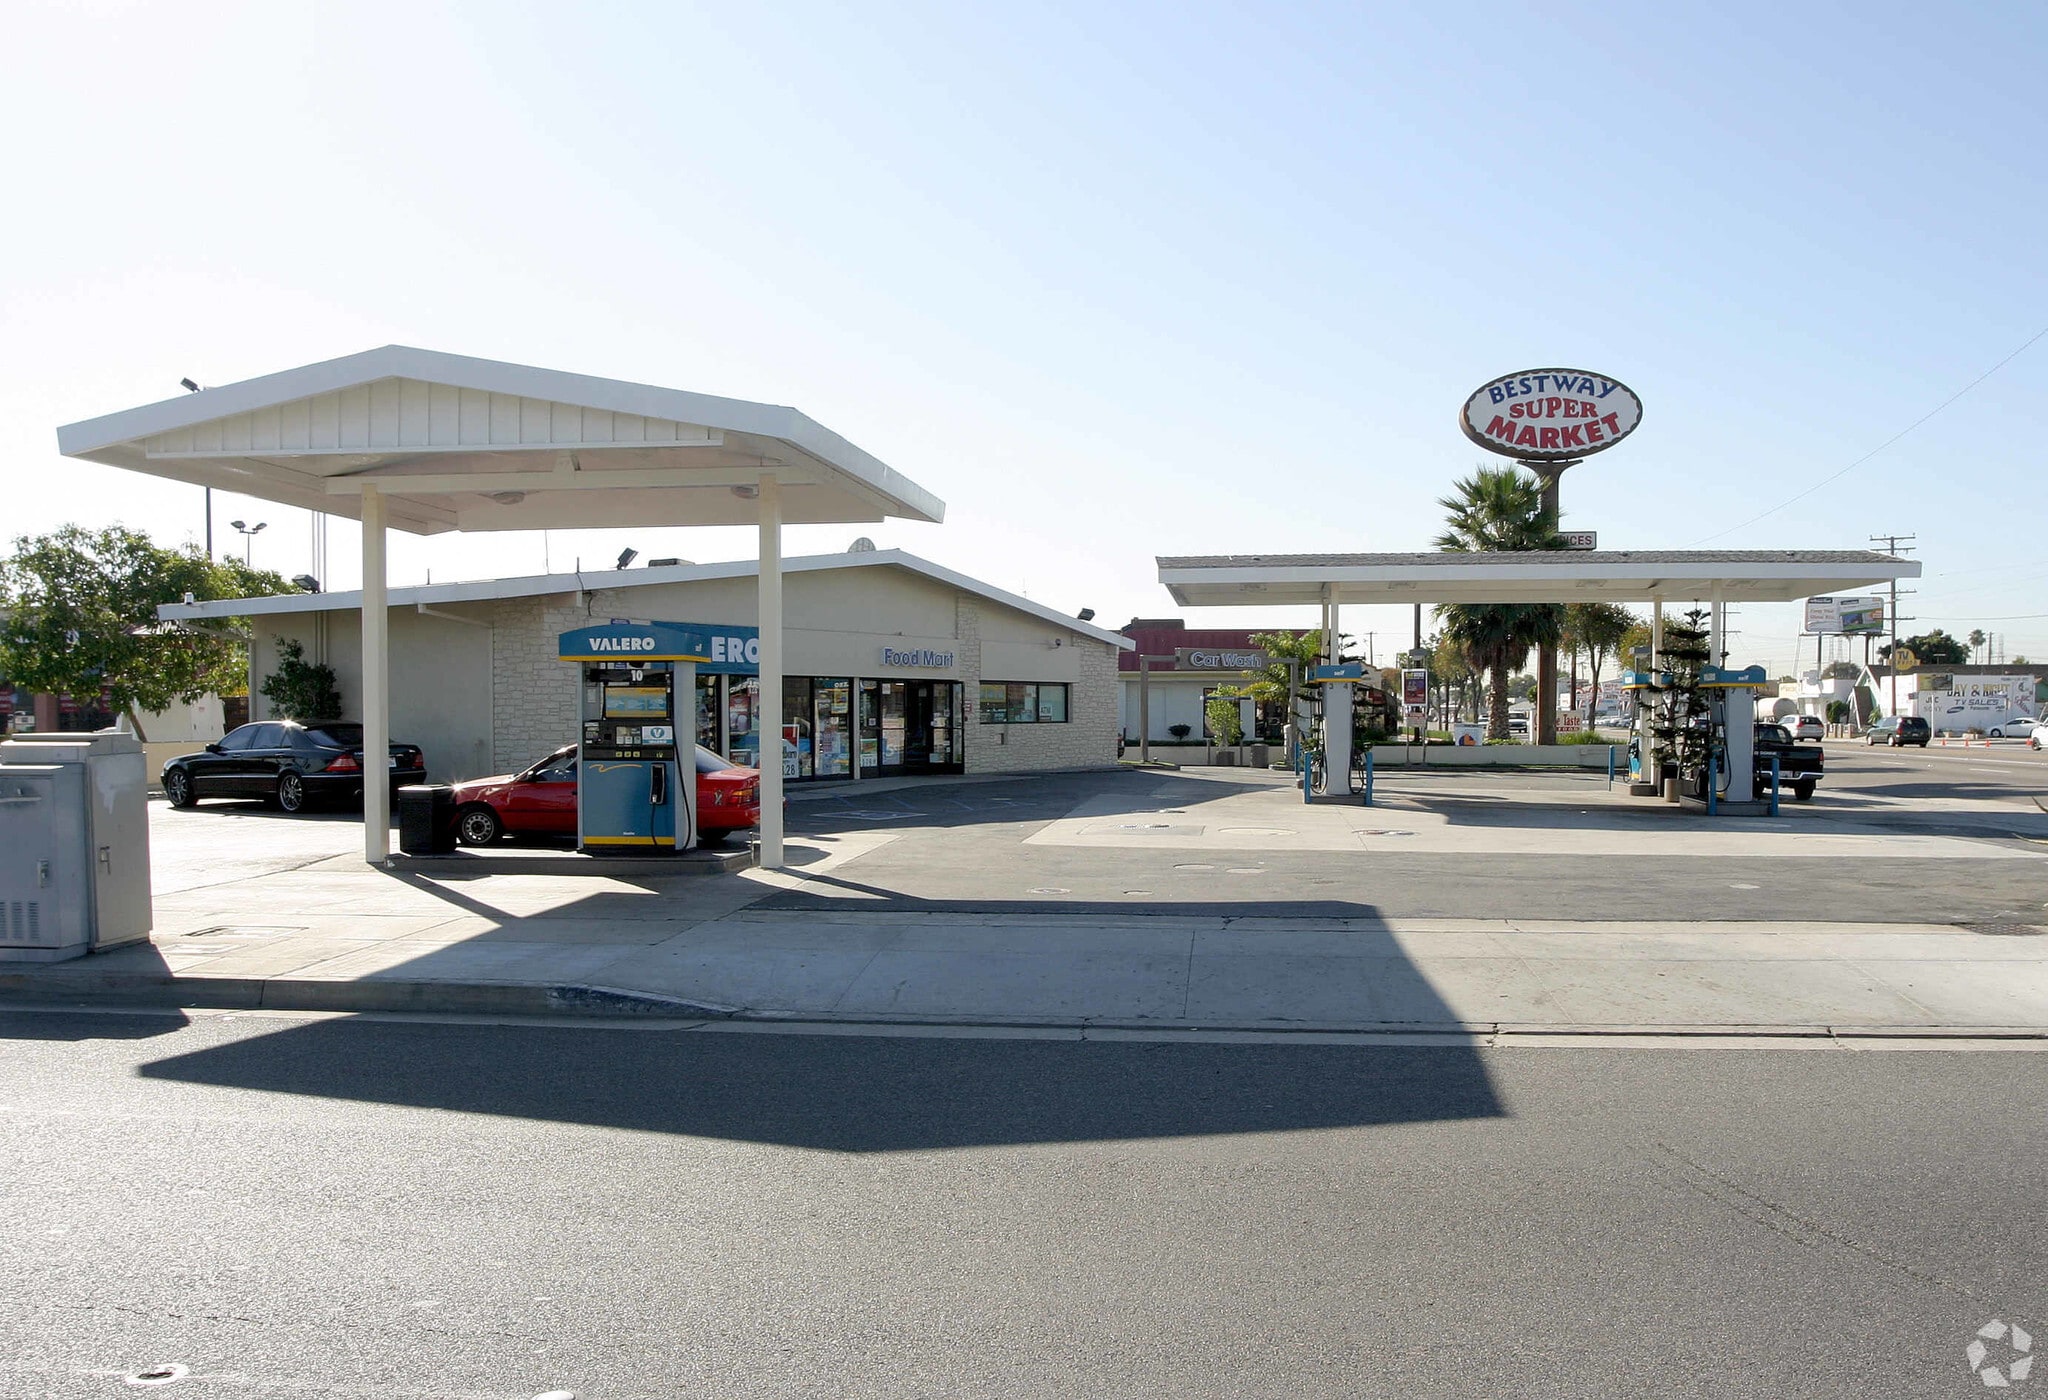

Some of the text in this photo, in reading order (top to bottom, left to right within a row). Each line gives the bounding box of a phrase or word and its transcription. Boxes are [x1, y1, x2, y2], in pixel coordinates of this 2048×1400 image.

[1488, 375, 1619, 404] BESTWAY
[1509, 397, 1599, 418] SUPER
[1484, 412, 1621, 449] MARKET
[589, 637, 656, 651] VALERO
[711, 636, 760, 664] ERO
[884, 647, 954, 667] Food Mart
[1190, 651, 1262, 668] Car Wash
[1897, 651, 1909, 659] TV
[630, 669, 644, 682] 10
[1971, 684, 1981, 697] &
[1925, 696, 1940, 704] JC
[1563, 713, 1580, 725] Taste
[782, 764, 796, 776] .28
